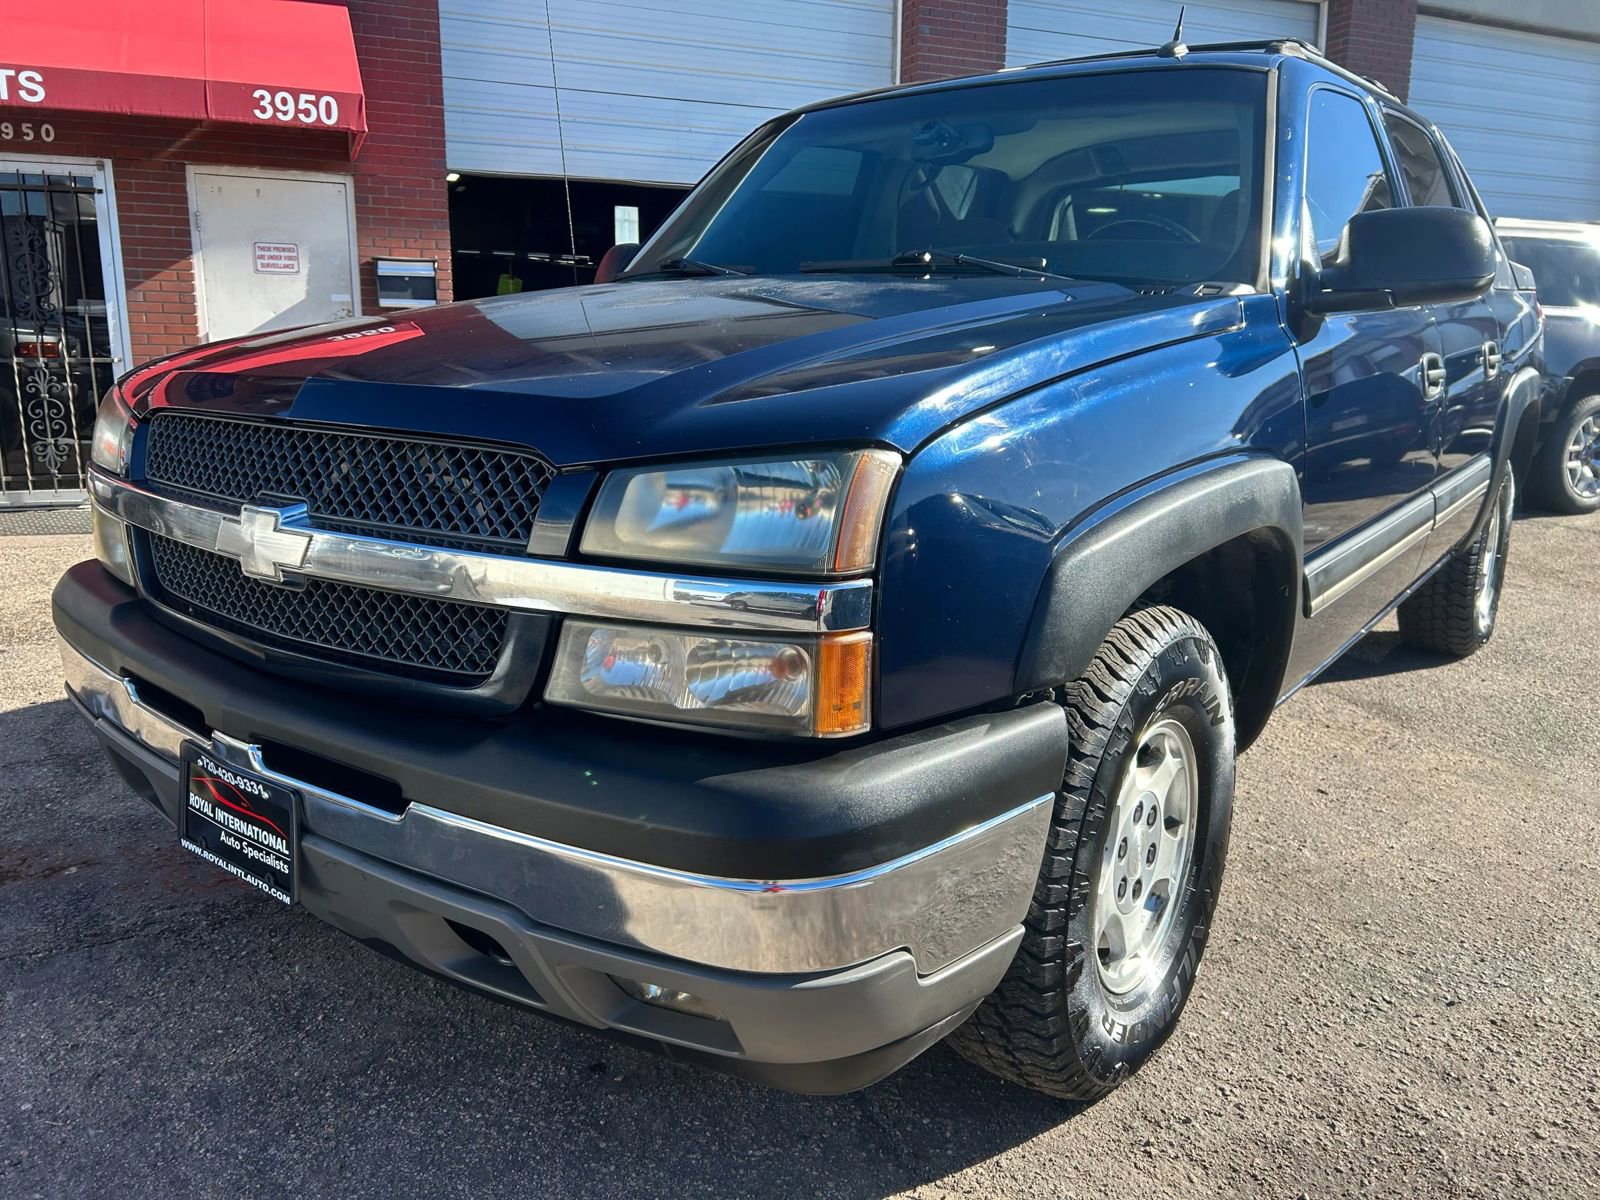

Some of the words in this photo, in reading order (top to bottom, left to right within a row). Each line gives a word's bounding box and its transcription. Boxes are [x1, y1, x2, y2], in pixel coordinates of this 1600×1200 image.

[252, 89, 339, 126] 3950
[189, 792, 214, 818] ROYAL
[215, 807, 290, 856] INTERNATIONAL
[180, 837, 291, 905] WWW.ROYALINTLAUTO.COM
[220, 830, 241, 850] Auto
[242, 842, 290, 874] Specialists
